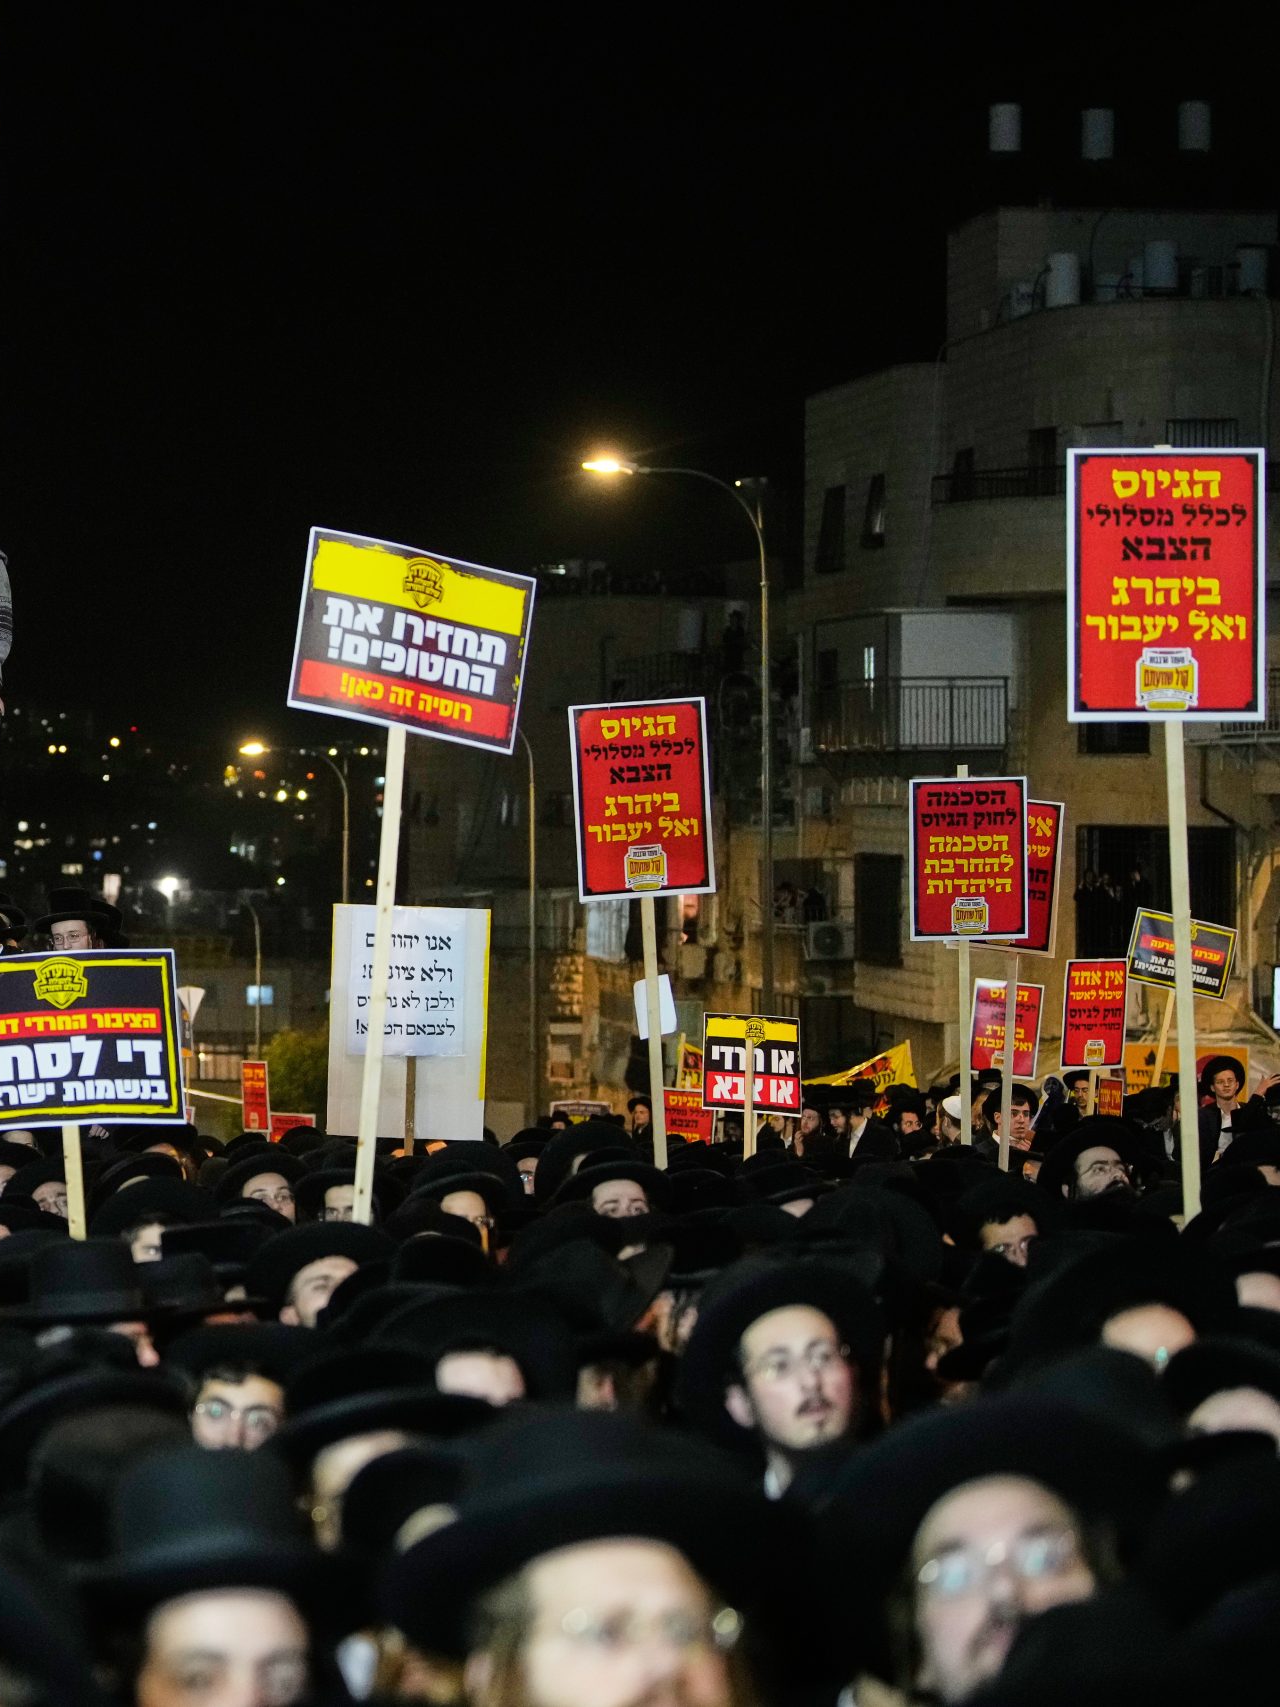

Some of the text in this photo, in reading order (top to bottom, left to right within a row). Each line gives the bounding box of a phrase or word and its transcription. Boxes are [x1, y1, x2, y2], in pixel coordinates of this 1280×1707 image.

[1111, 468, 1221, 499] הגיוס
[1087, 503, 1247, 527] לכלל מסלולי
[1121, 537, 1212, 561] הצבא
[1111, 576, 1221, 606] ביהרג
[322, 596, 507, 666] תחזירו את
[1086, 609, 1247, 643] ואל יעבור
[327, 627, 497, 696] החטופים!
[1175, 668, 1188, 690] קול
[340, 672, 472, 722] רוסיה זה כאן!
[601, 715, 676, 740] הגיוס
[584, 739, 696, 761] לכלל מסלולי
[610, 763, 672, 784] הצבא
[604, 792, 680, 817] ביהרג
[927, 789, 1006, 807] הסכמה
[921, 807, 1017, 829] לחוק הגיוס
[1028, 816, 1053, 837] אי
[588, 817, 699, 843] ואל יעבור
[929, 834, 1009, 853] הסכמה
[924, 854, 1014, 874] להחרבת
[926, 877, 1012, 895] היהדות
[425, 936, 451, 950] אנו
[421, 960, 453, 982] ולא
[1071, 970, 1124, 989] אין אחד
[402, 990, 420, 1008] לא
[425, 991, 454, 1011] ולכן
[1070, 989, 1123, 1001] שיכול לאשר
[92, 1013, 157, 1029] הציבור
[1070, 1005, 1122, 1020] חוק לגיוס
[24, 1015, 88, 1033] החרדי
[356, 1018, 455, 1036] לצבאם הטא!
[976, 1036, 1004, 1048] עבור
[116, 1039, 163, 1076] די
[771, 1049, 794, 1075] או
[62, 1078, 168, 1101] בנשמות
[770, 1079, 793, 1104] או
